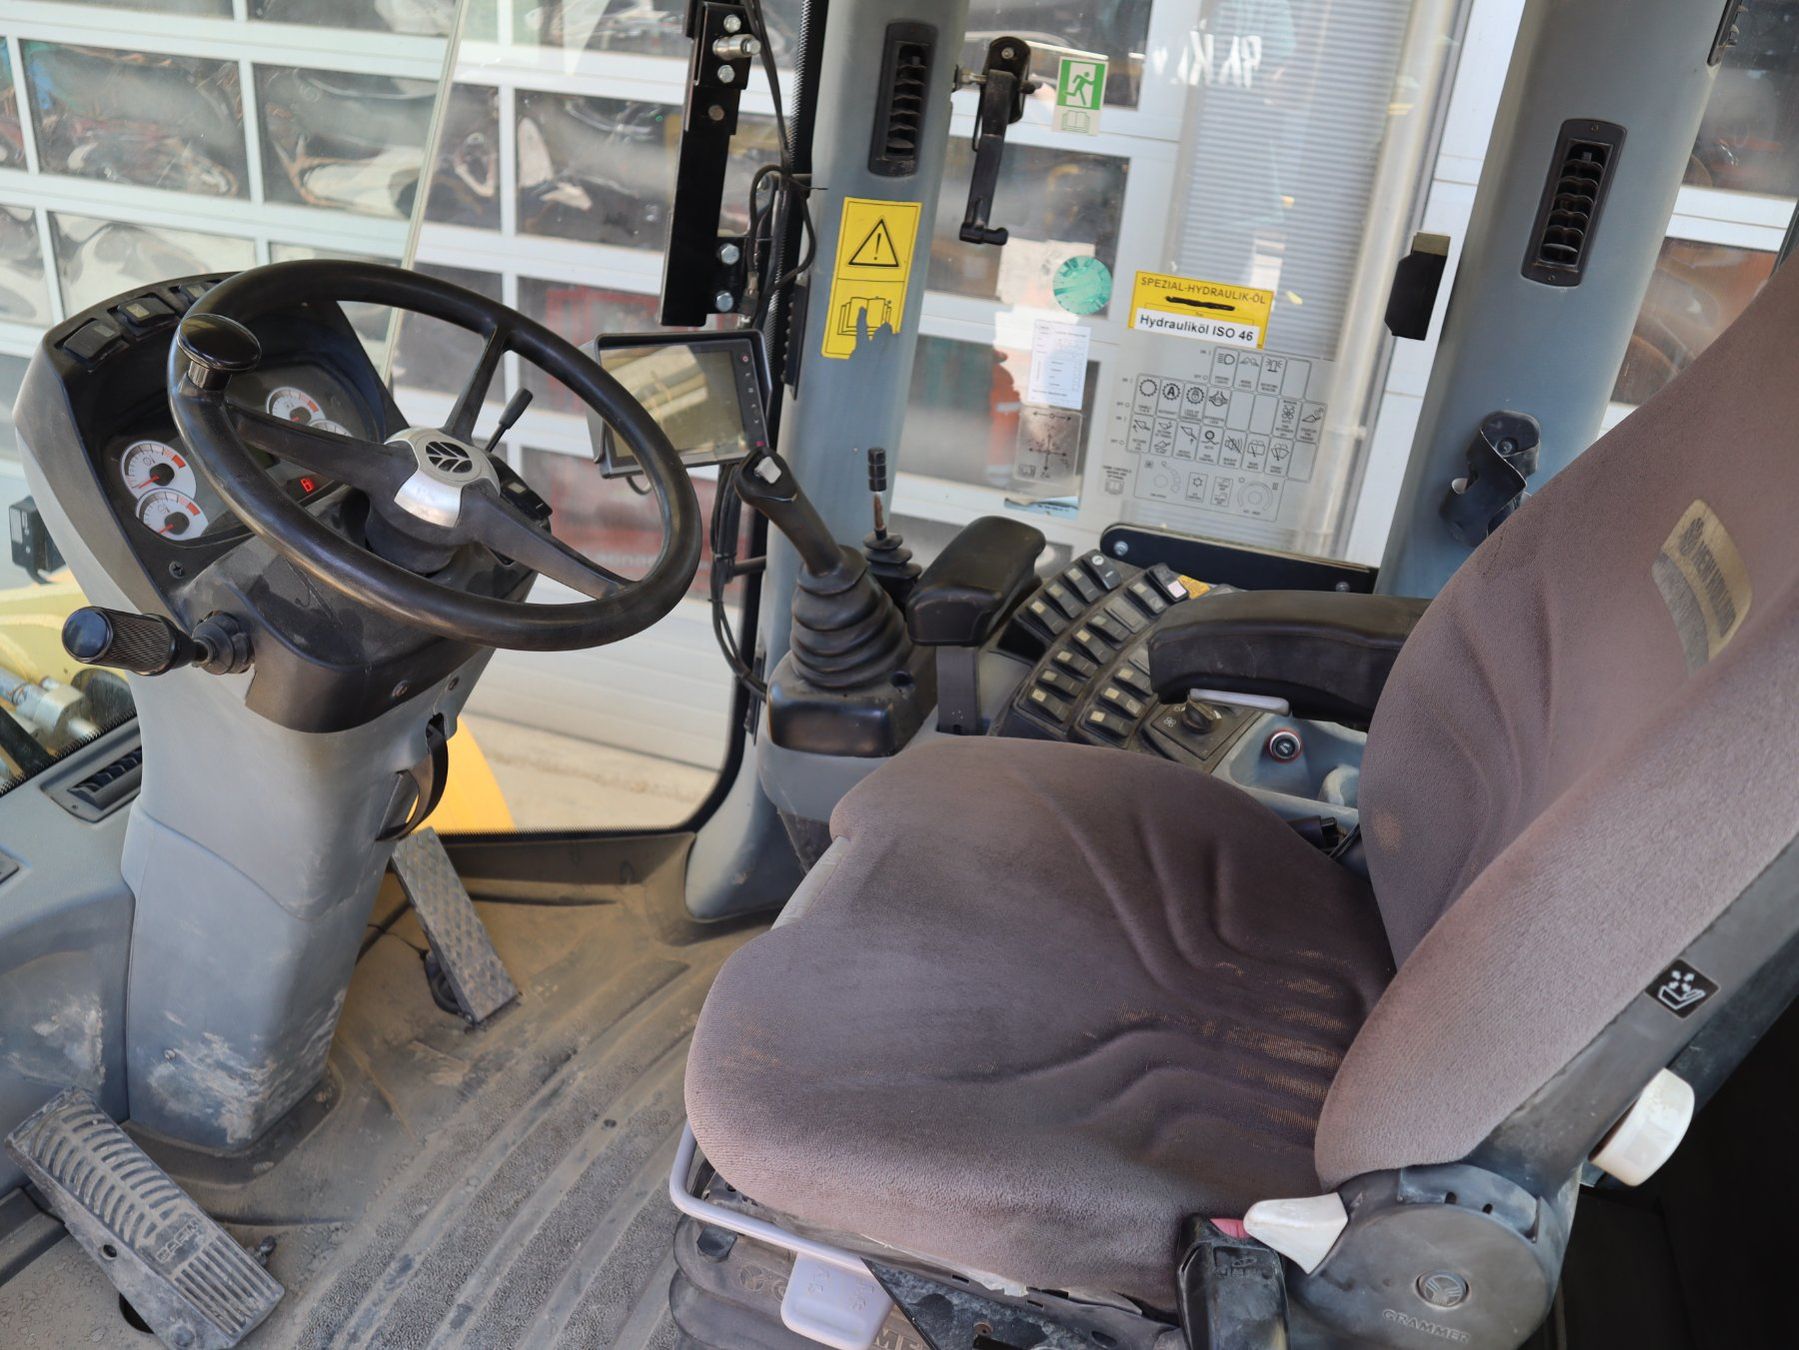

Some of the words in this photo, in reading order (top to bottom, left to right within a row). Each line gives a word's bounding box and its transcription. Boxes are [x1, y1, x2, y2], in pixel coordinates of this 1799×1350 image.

[1141, 277, 1266, 304] SPEZIAL-HYDRAULIK-ÖL
[1139, 314, 1209, 335] Hydrauliköl
[1212, 326, 1236, 339] ISO
[1238, 330, 1254, 342] 46
[1382, 1308, 1471, 1343] GRAMMER
